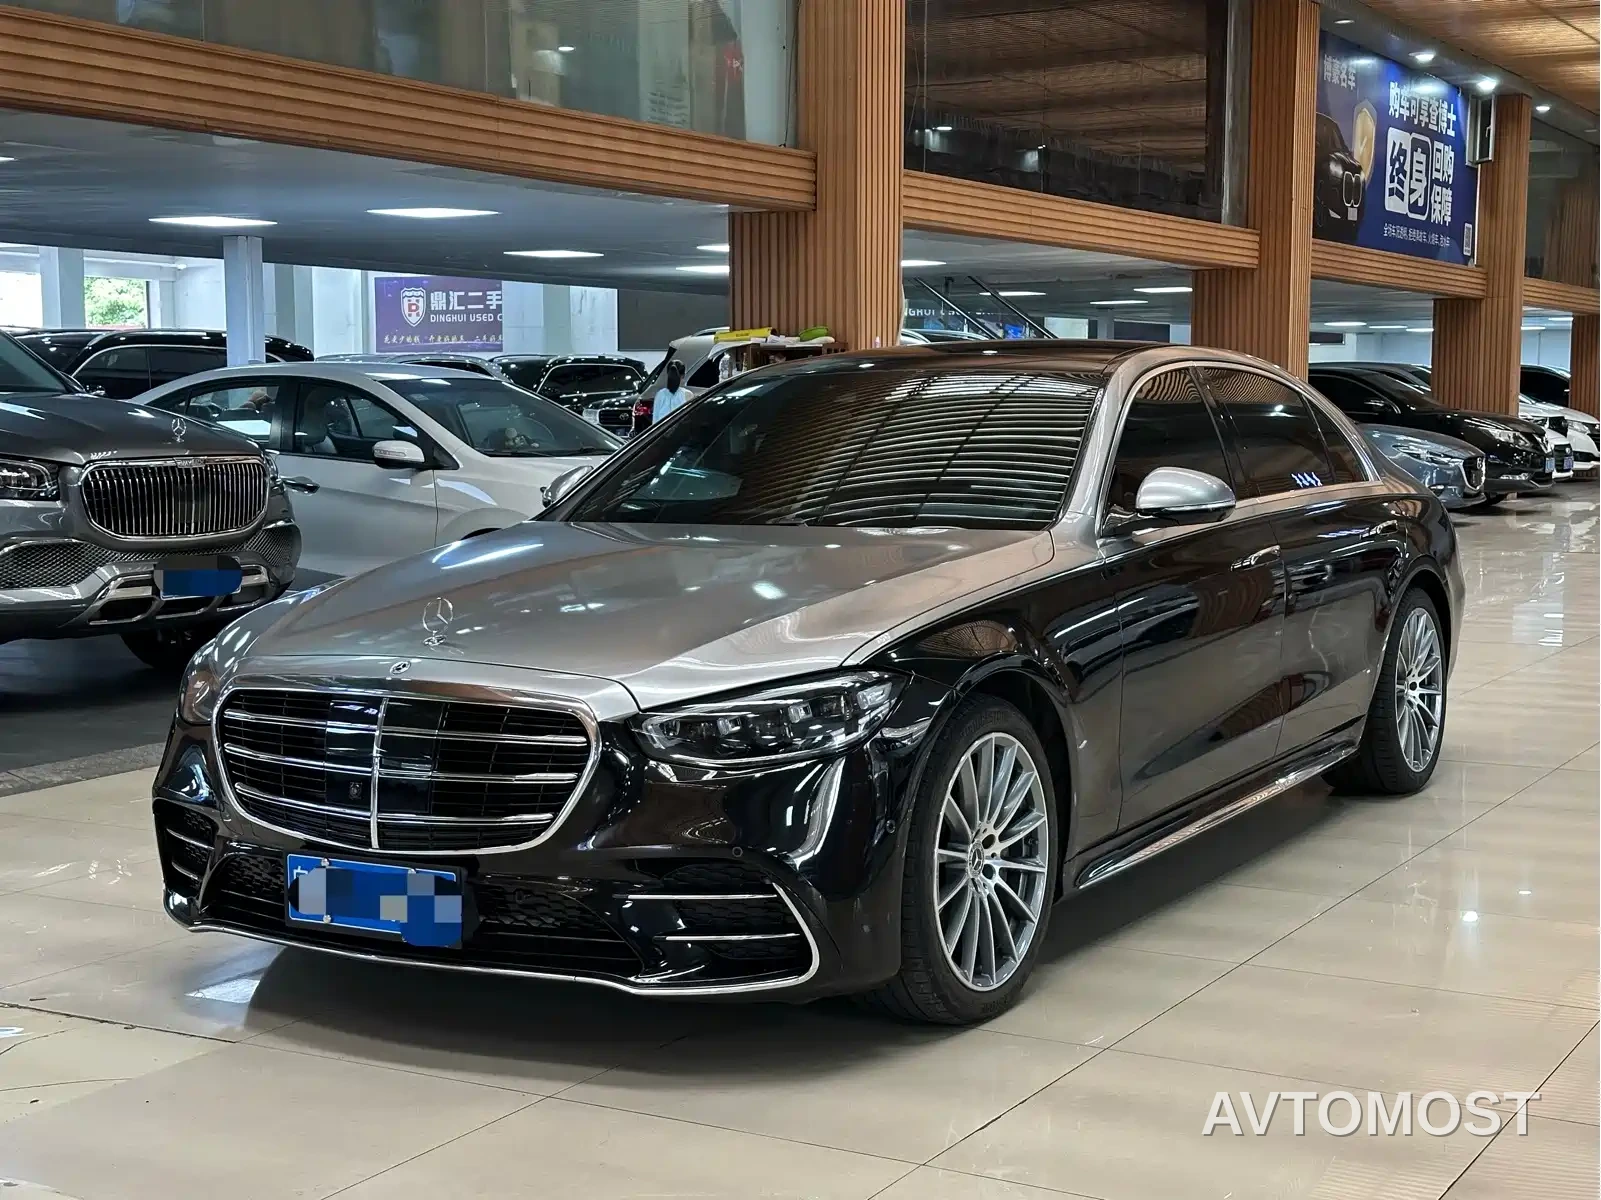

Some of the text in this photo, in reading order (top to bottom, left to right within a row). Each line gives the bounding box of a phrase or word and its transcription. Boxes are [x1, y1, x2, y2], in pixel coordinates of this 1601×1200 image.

[1388, 80, 1457, 138] 购车可享查博士
[1387, 135, 1429, 212] 终身
[1432, 140, 1455, 185] 回购
[1430, 184, 1453, 226] 保障
[430, 314, 467, 322] DINGHUI
[469, 313, 494, 322] USED
